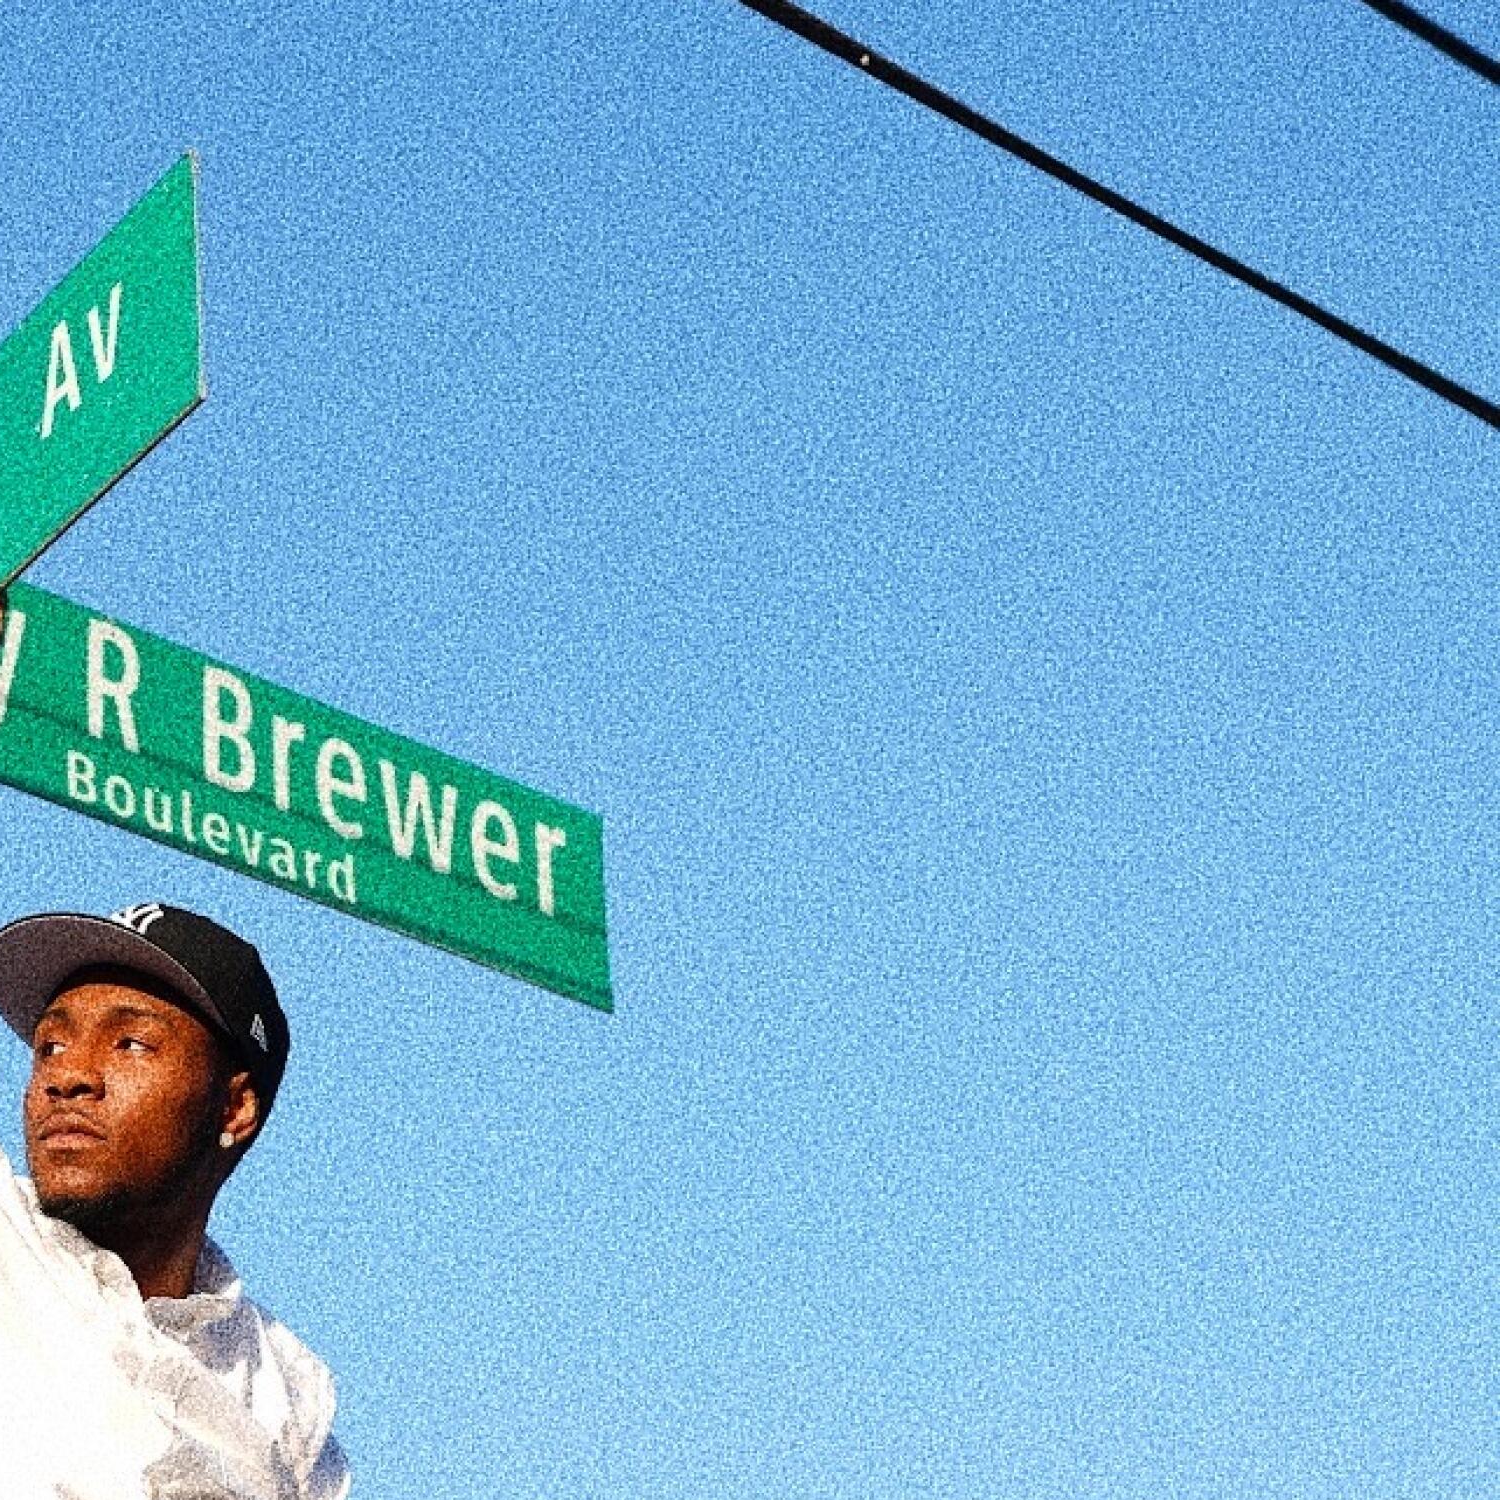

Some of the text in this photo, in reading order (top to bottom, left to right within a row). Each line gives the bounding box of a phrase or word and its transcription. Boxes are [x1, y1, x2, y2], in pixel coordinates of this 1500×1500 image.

[40, 282, 122, 439] AV
[66, 750, 357, 903] Boulevard
[85, 617, 141, 752] R
[202, 665, 568, 917] Brewer
